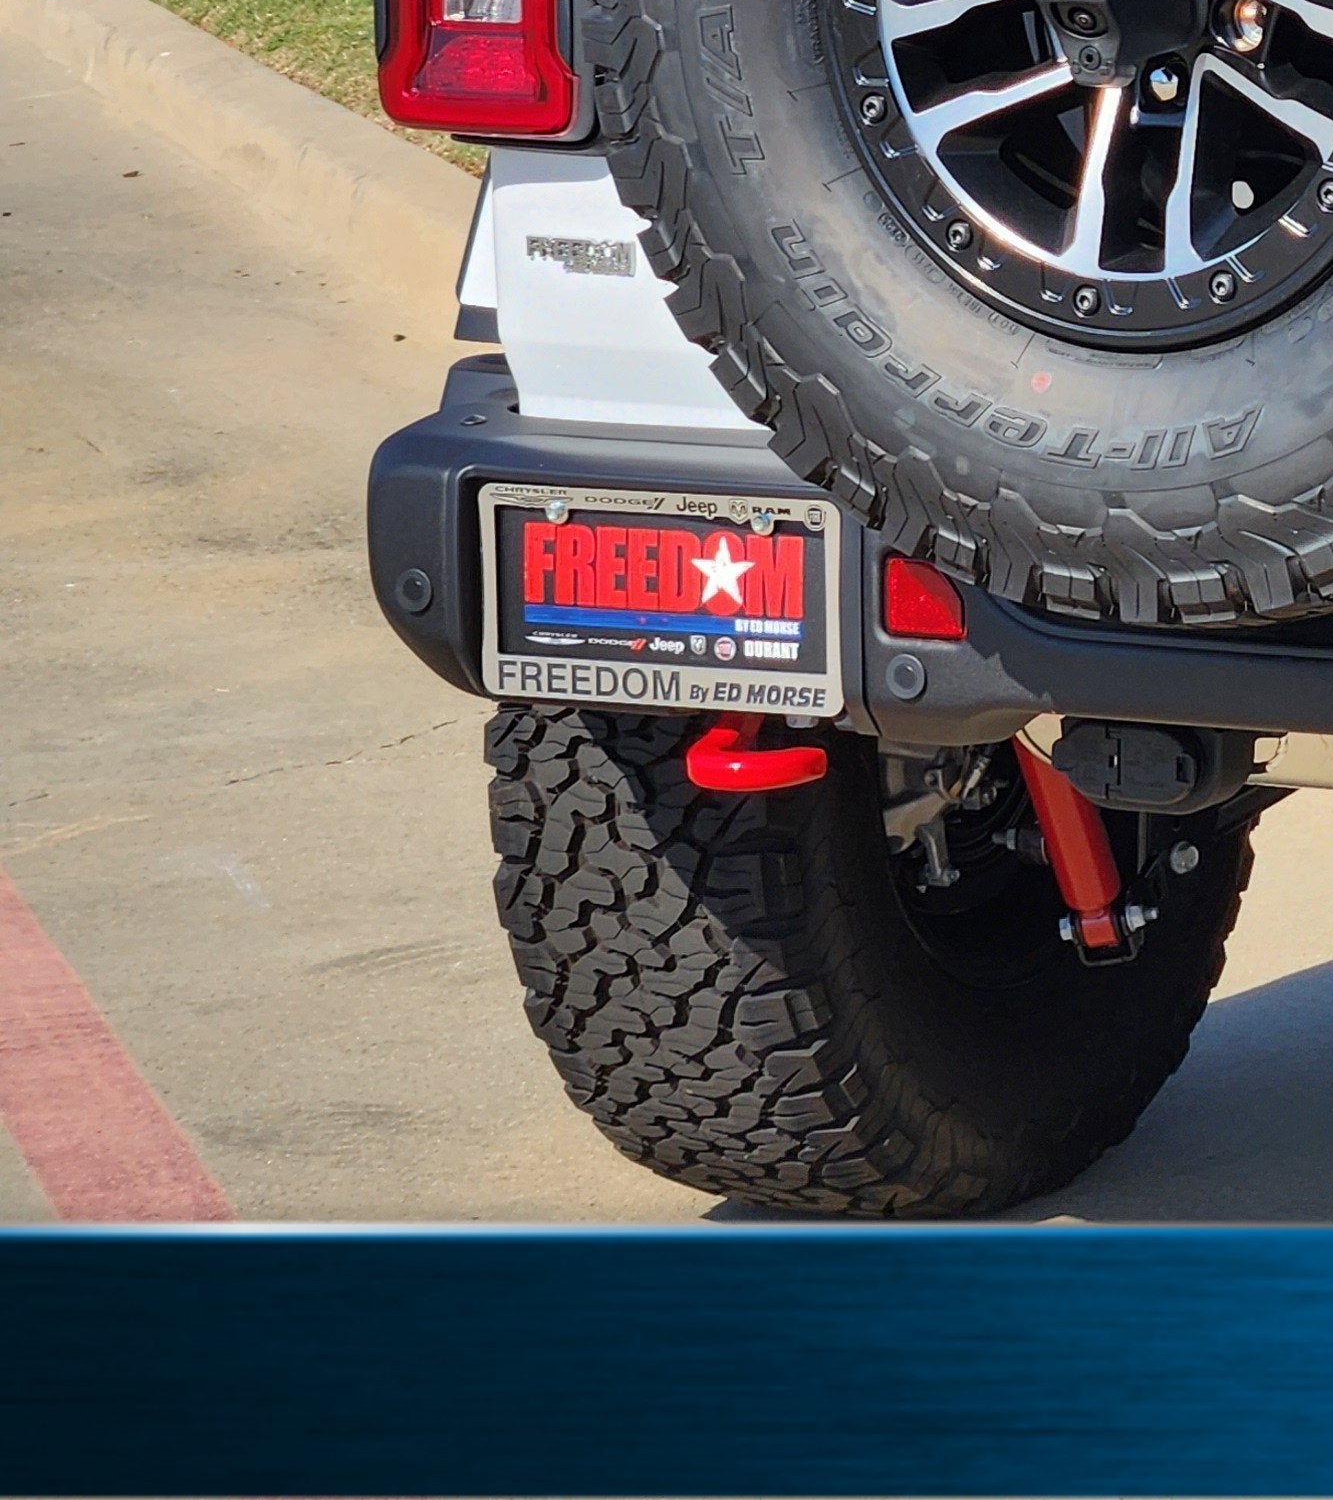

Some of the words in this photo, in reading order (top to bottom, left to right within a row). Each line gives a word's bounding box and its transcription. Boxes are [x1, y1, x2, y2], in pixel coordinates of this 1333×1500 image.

[699, 3, 766, 176] T/A
[769, 218, 1264, 472] All-Terrain
[494, 485, 567, 496] CHRYSLER
[676, 497, 718, 515] Jeep
[752, 506, 791, 516] RAM
[524, 521, 804, 619] FREEDOM
[764, 621, 800, 635] MORSE
[649, 637, 686, 654] Jeep
[744, 640, 800, 660] DURANT
[498, 660, 682, 702] FREEDOM
[689, 684, 709, 703] By
[713, 682, 742, 702] ED
[746, 684, 827, 708] MORSE
